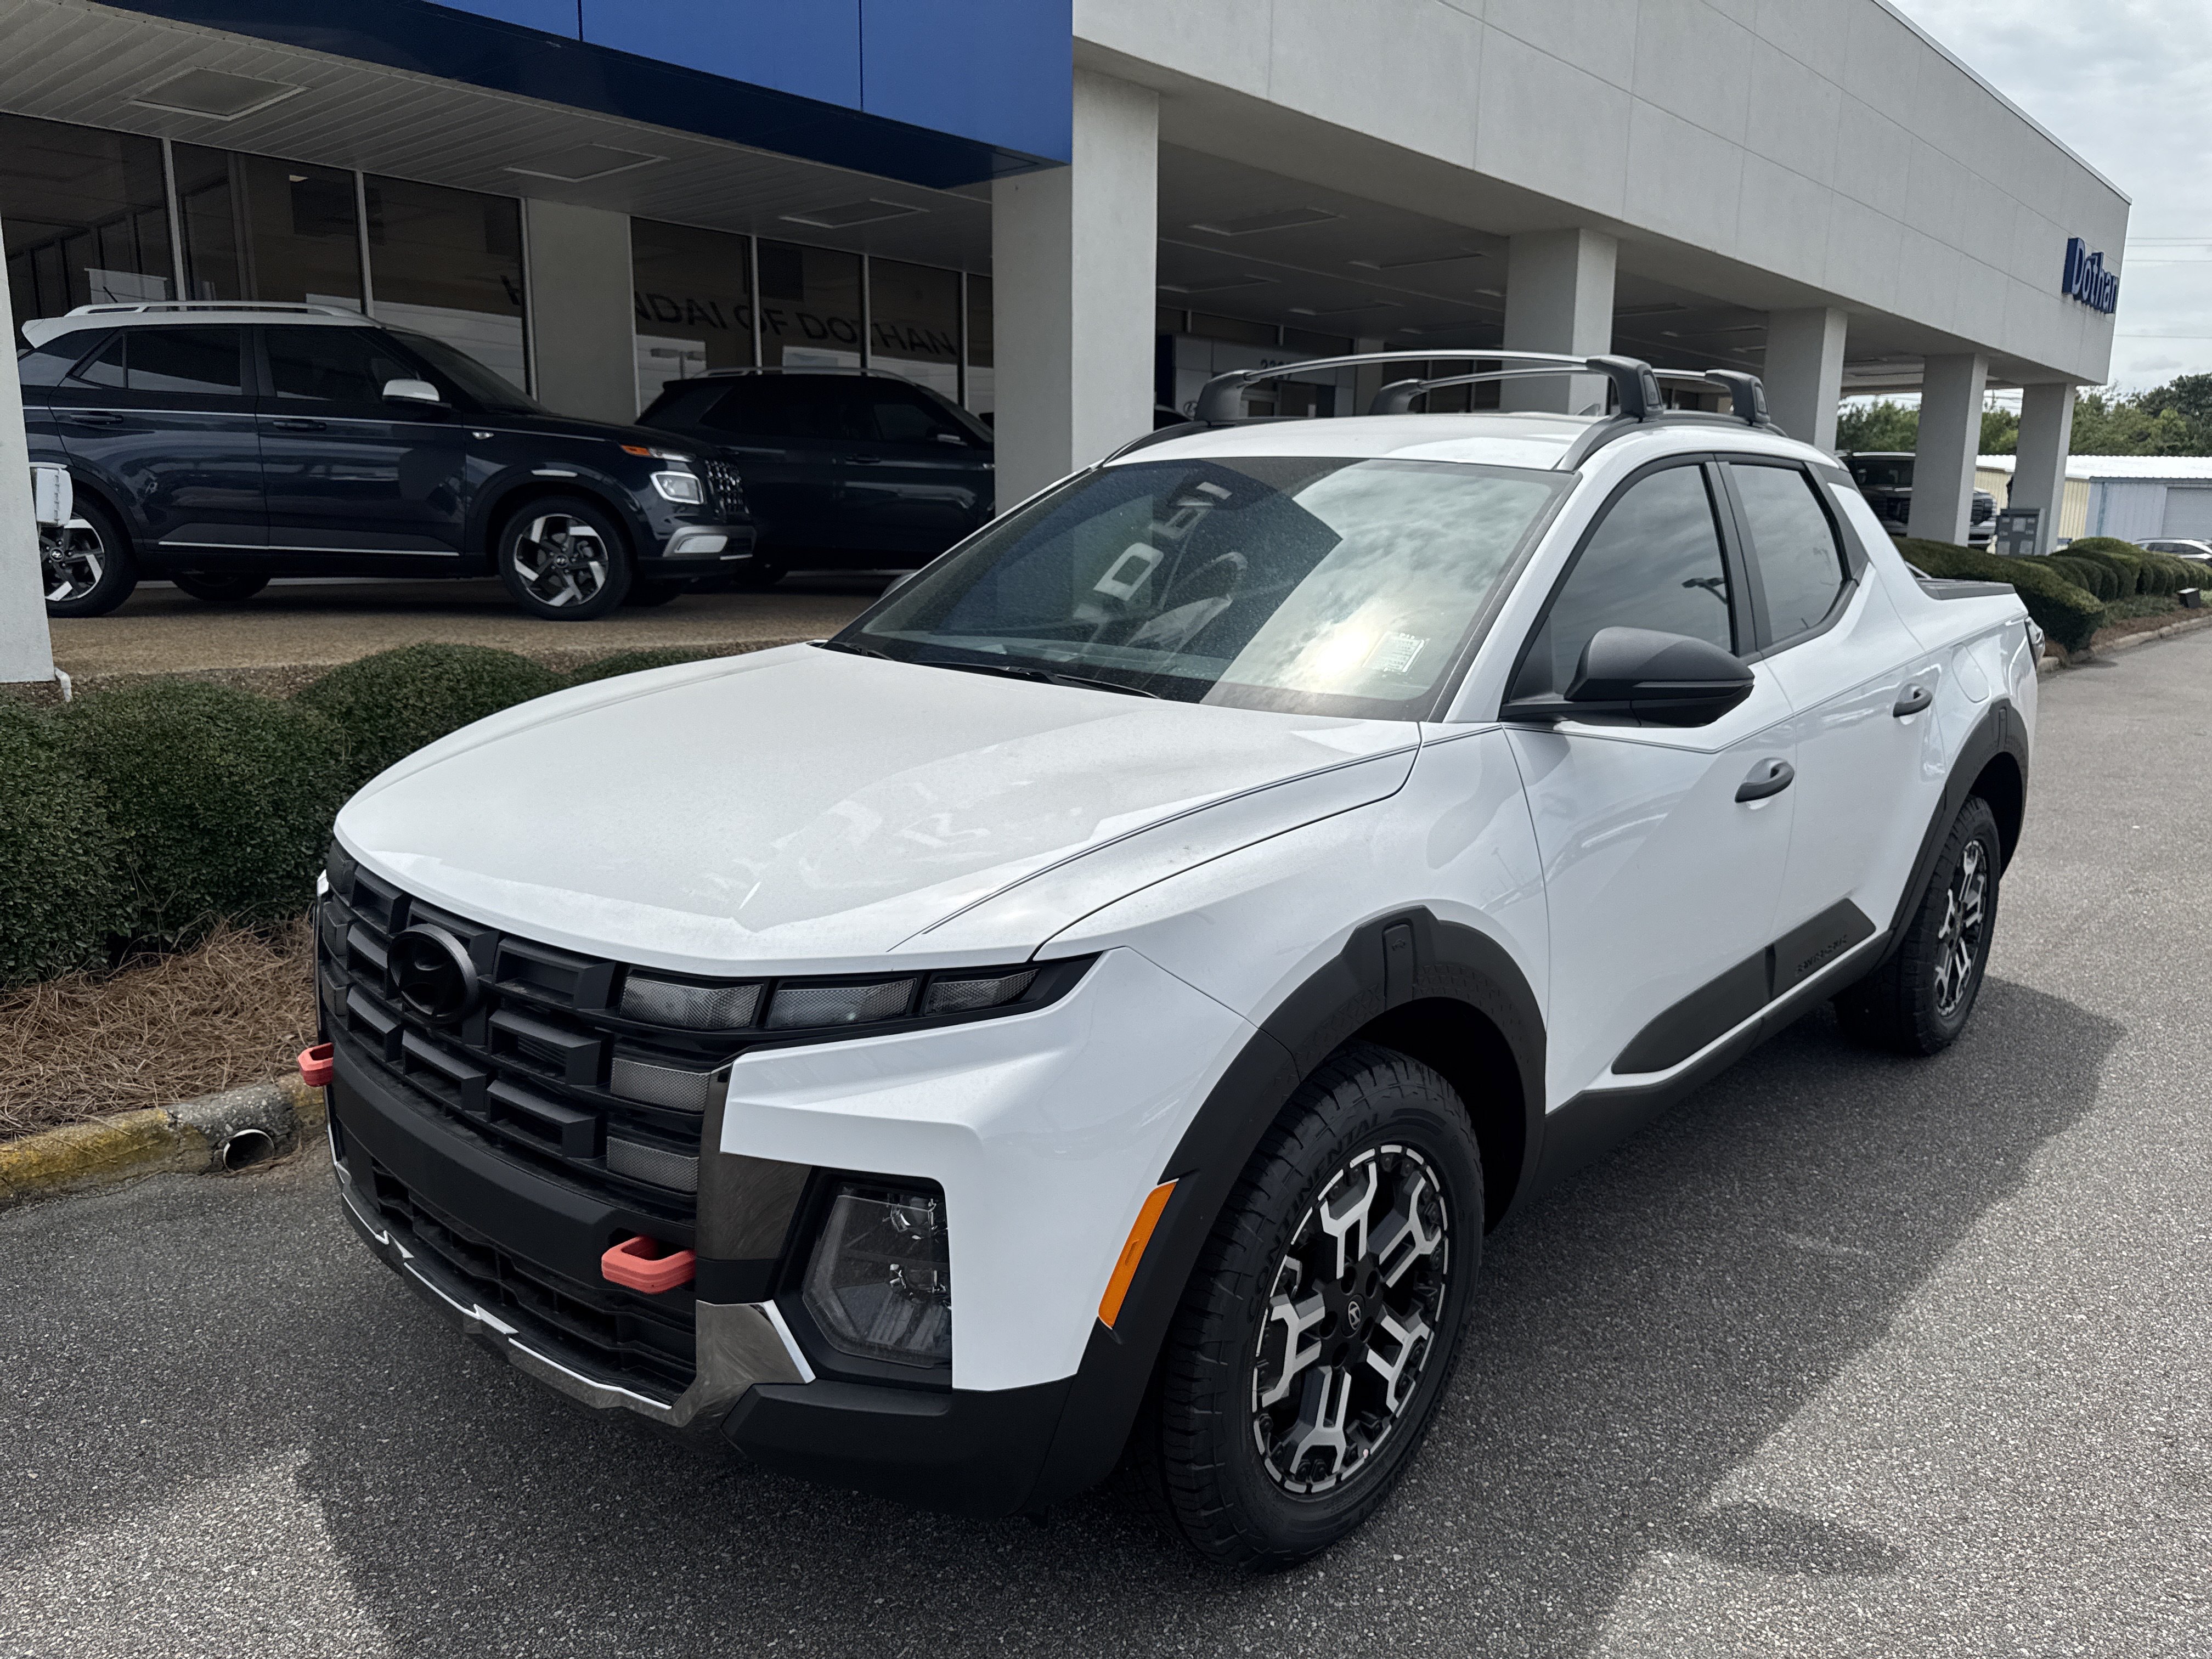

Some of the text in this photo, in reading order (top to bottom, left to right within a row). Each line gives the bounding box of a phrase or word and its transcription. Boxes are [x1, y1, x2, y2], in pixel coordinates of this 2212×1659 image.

[2064, 238, 2119, 313] Dothan
[732, 304, 788, 335] OF
[1246, 1113, 1379, 1324] CONTINENTAL
